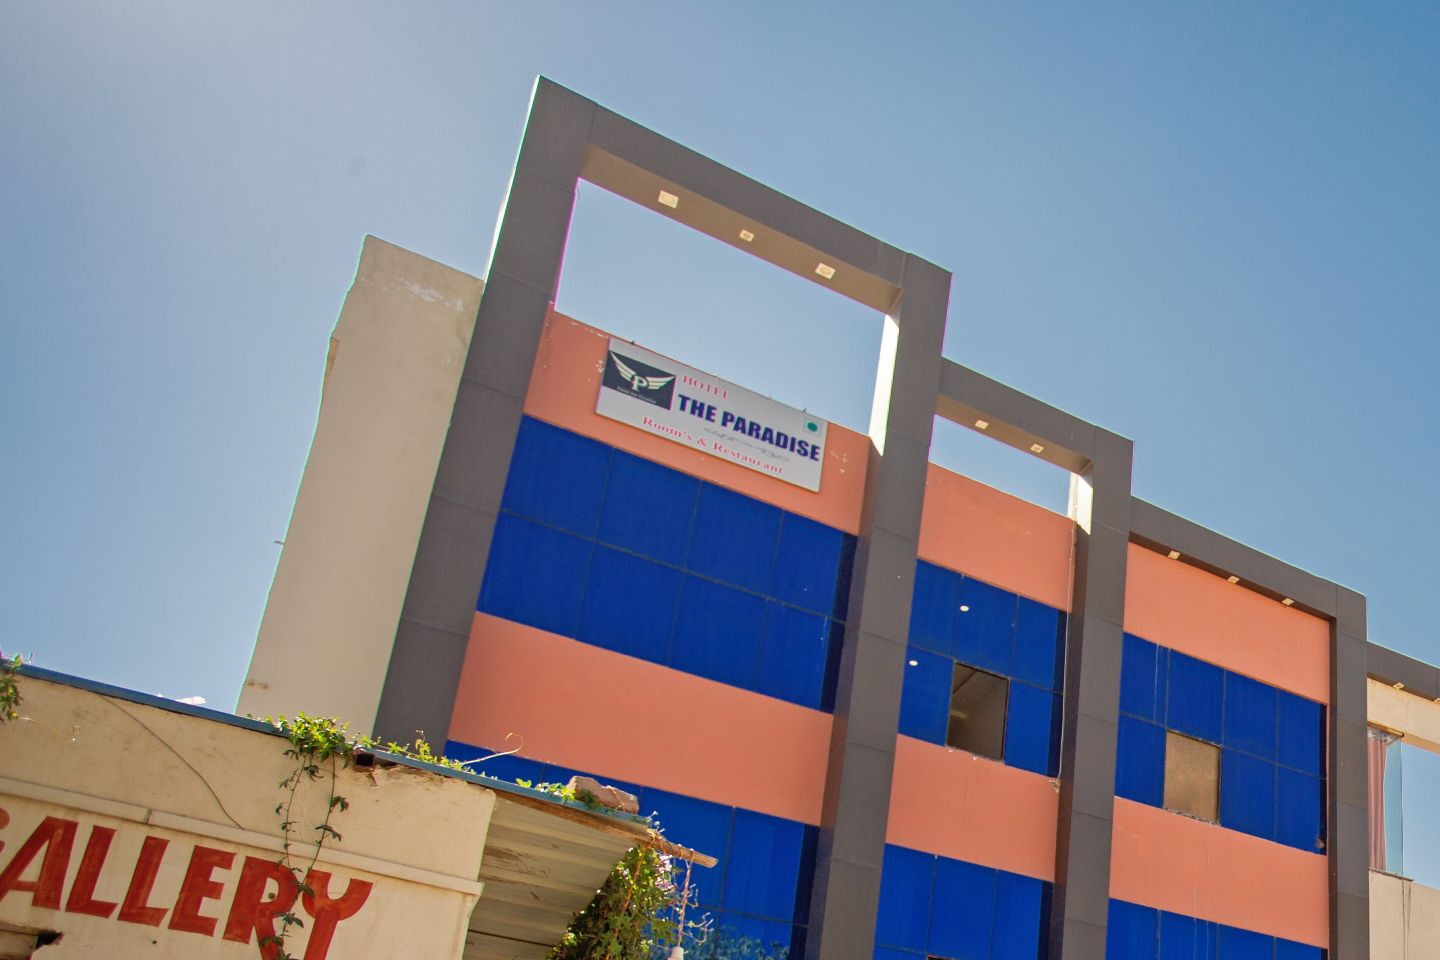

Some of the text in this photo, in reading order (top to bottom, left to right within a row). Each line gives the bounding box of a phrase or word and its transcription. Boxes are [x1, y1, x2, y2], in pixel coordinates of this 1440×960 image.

[682, 375, 729, 400] HOTEL
[643, 416, 784, 475] Room's & Restaurant
[678, 394, 717, 423] THE
[721, 410, 821, 462] PARADISE
